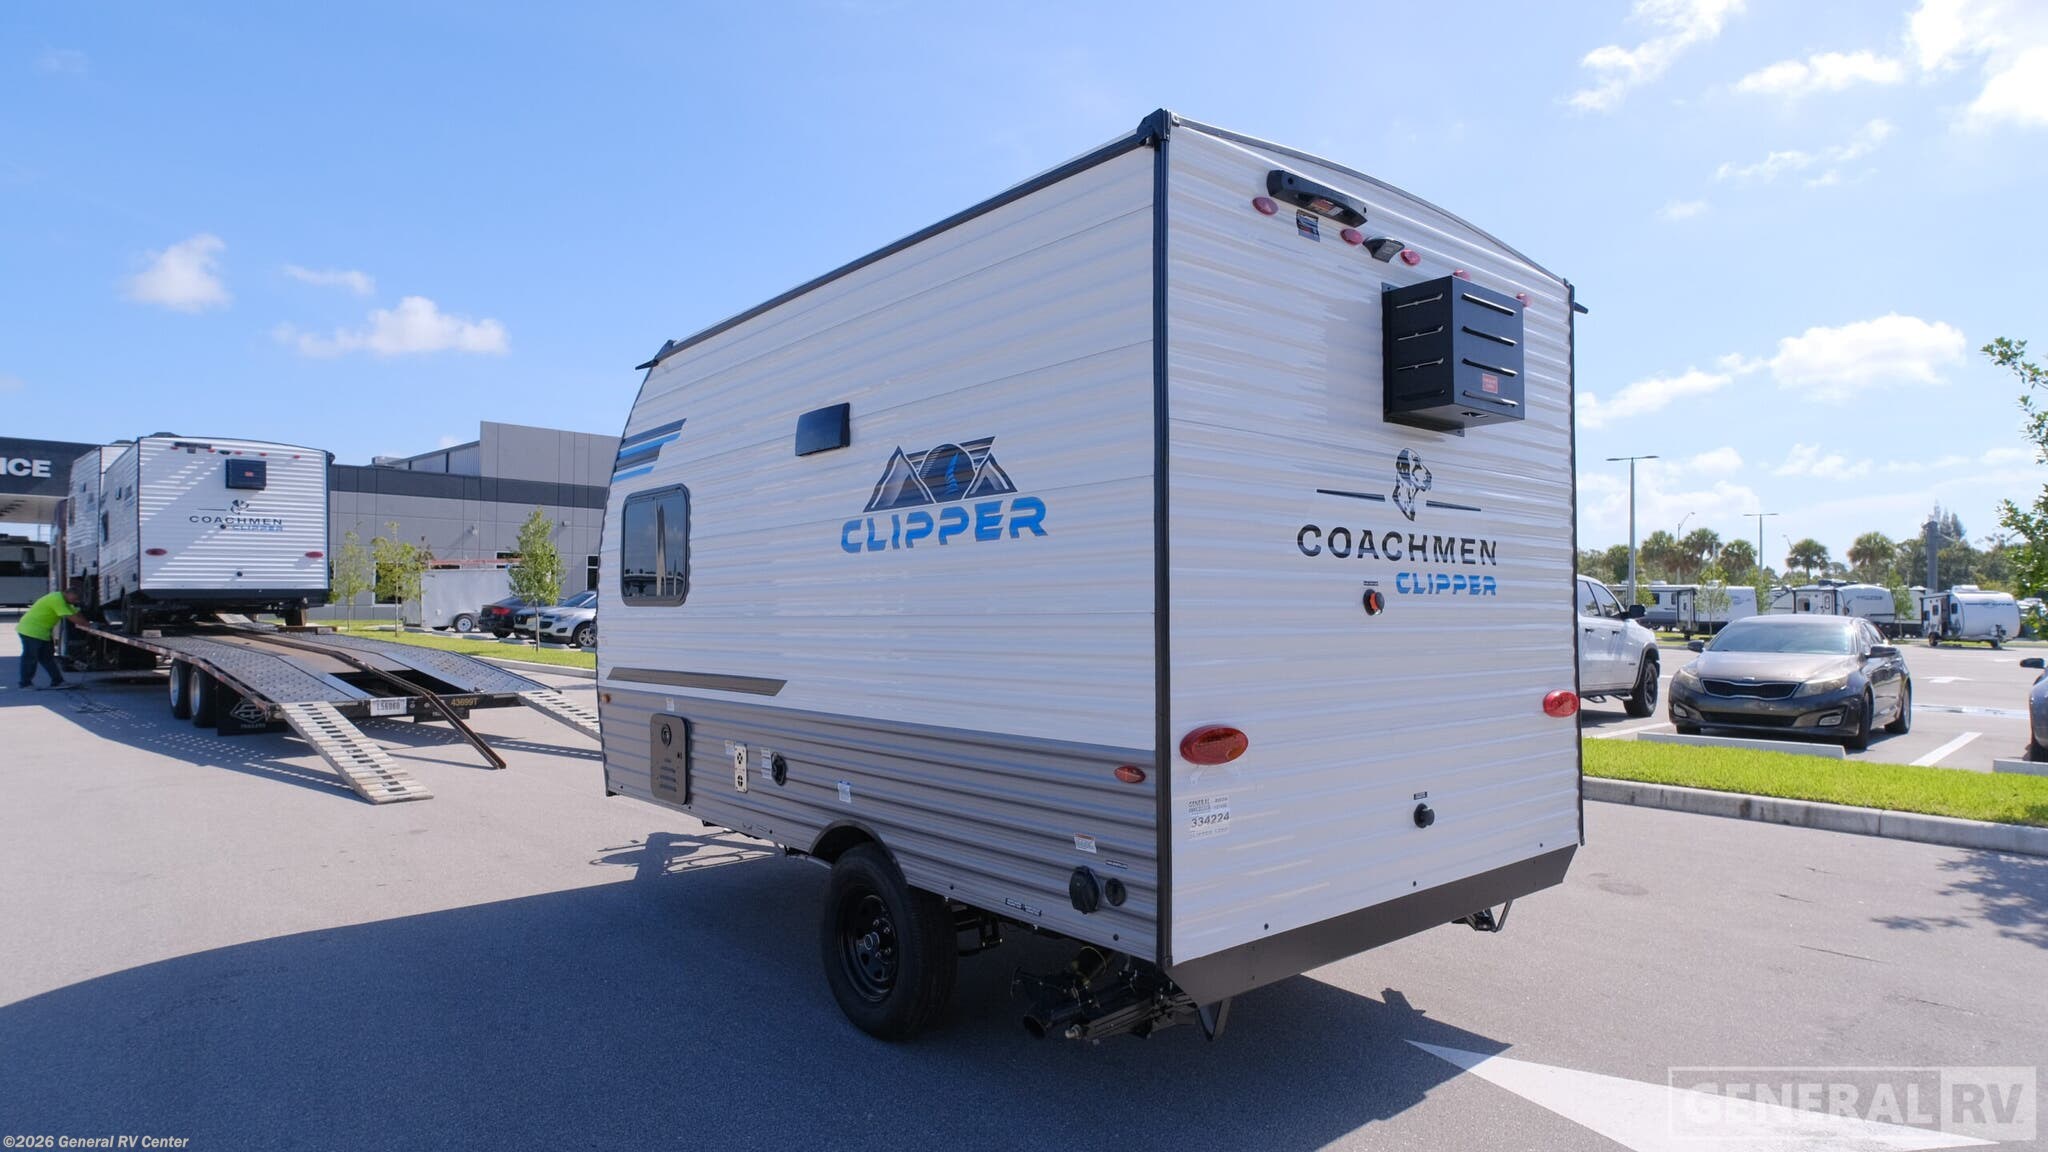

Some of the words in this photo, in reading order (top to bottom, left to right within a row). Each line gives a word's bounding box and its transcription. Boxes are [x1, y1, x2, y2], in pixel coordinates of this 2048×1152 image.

[189, 515, 282, 525] COACHMEN
[840, 496, 1049, 553] CLIPPER
[1297, 524, 1497, 566] COACHMEN
[1395, 572, 1497, 596] CLIPPER
[1191, 811, 1230, 828] 334224
